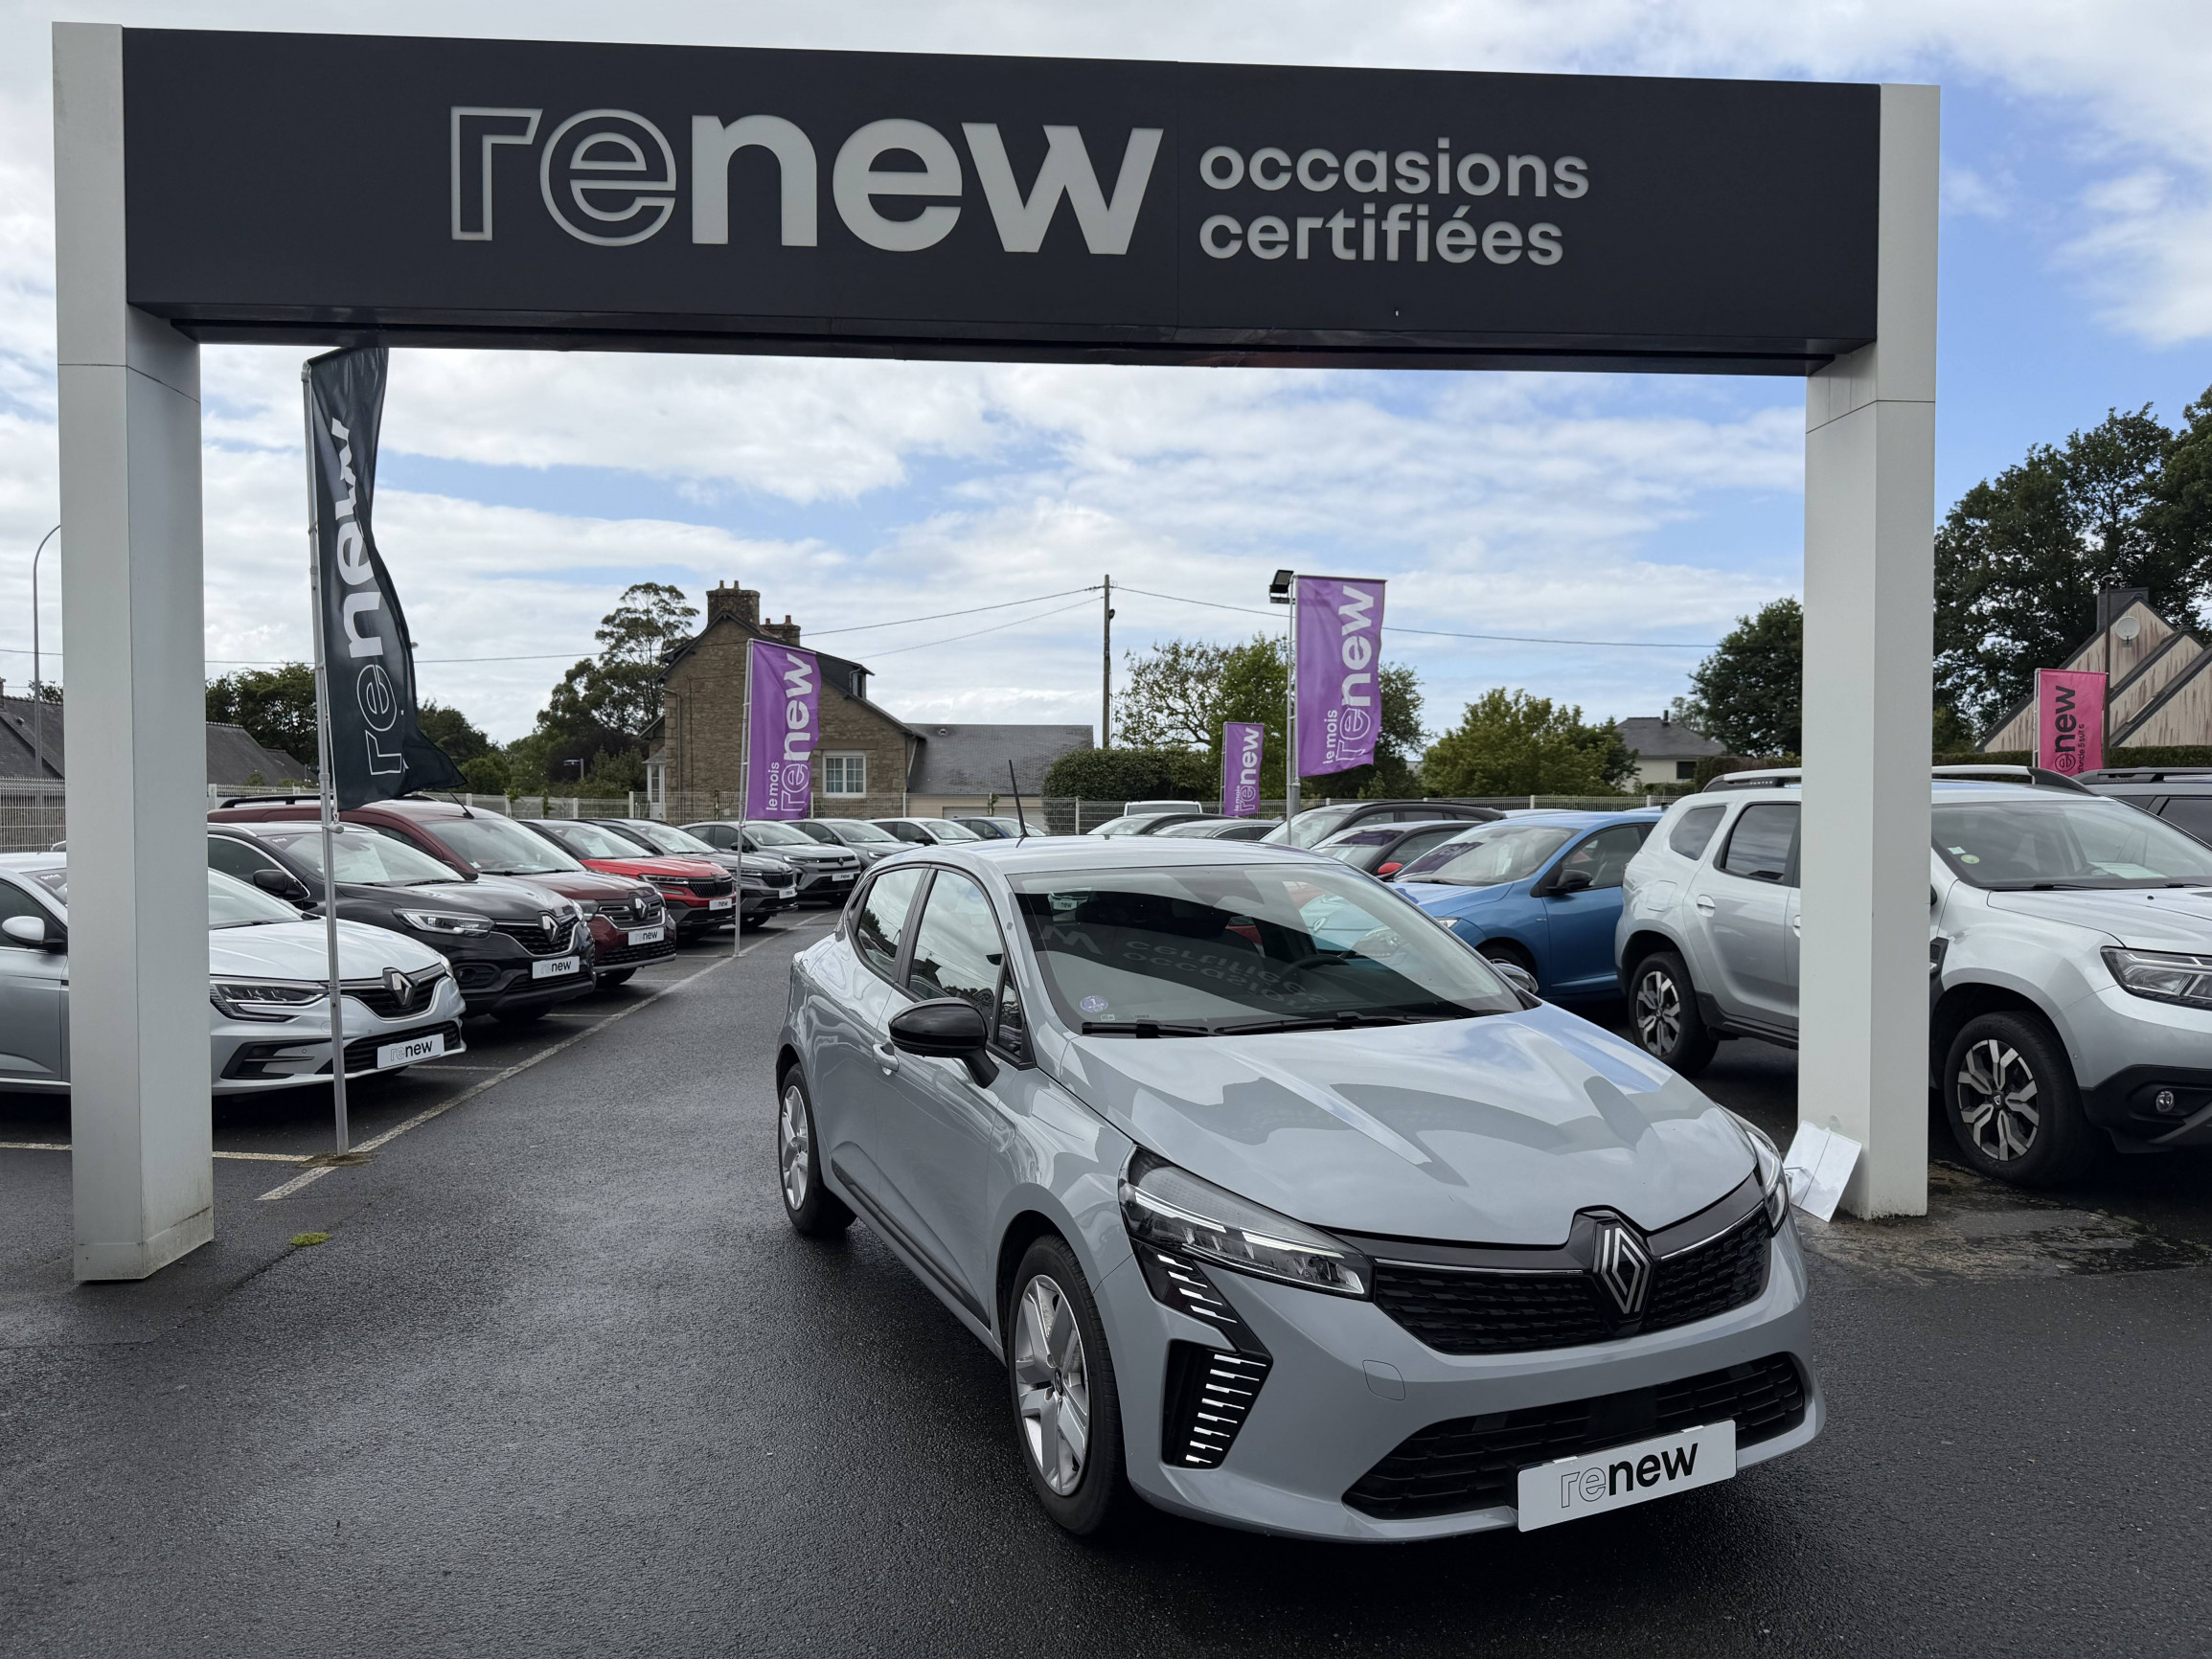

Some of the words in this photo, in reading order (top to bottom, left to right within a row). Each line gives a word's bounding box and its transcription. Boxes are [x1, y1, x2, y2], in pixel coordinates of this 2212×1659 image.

[450, 106, 1163, 255] renew
[1199, 137, 1589, 199] occasions
[1199, 202, 1563, 265] certifiées
[331, 417, 406, 776] renew
[1335, 585, 1374, 761] renew
[780, 652, 813, 811] renew
[1323, 749, 1334, 764] le
[1324, 709, 1337, 748] mois
[2055, 685, 2077, 773] enew
[768, 761, 780, 797] mois
[1239, 727, 1261, 812] renew
[765, 798, 778, 811] le
[540, 961, 572, 974] renew
[390, 1039, 433, 1061] renew
[1561, 1443, 1699, 1509] renew
